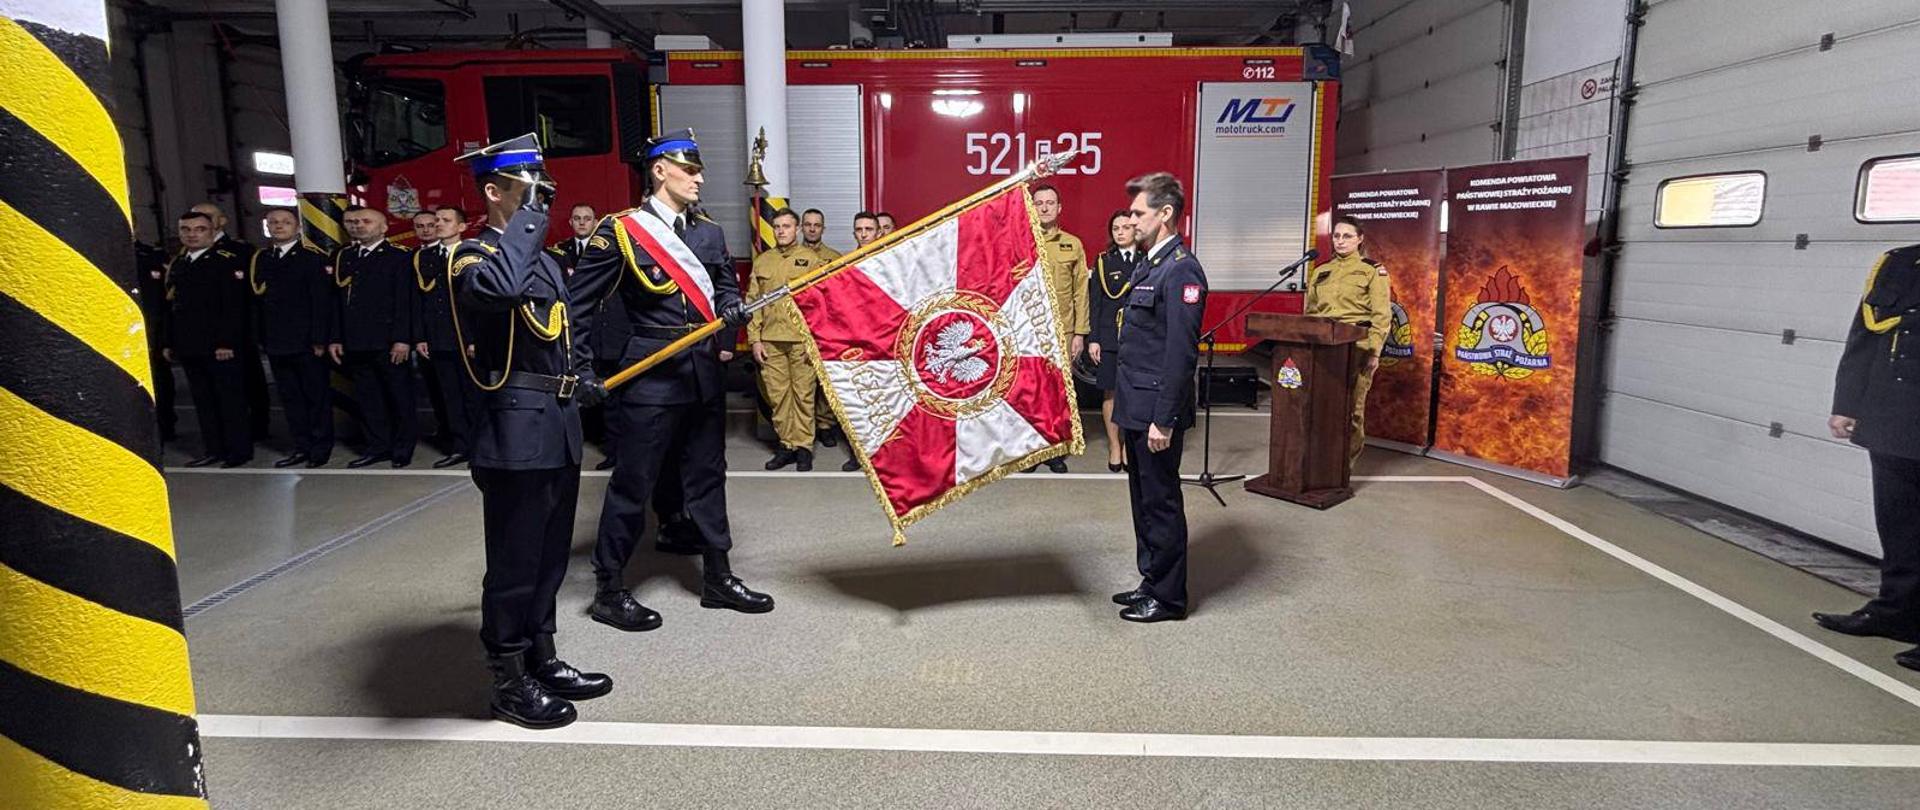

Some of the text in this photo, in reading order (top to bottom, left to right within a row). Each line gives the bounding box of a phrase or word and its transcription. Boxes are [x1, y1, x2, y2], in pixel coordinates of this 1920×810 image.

[1255, 67, 1275, 79] 112
[1216, 125, 1285, 134] mototruck.com
[1470, 173, 1557, 187] KOMENDA POWIATOWA
[1348, 188, 1419, 199] KOMENDA POWIATOWA
[1456, 184, 1572, 200] PAŃSTWOWEJ STRAŻY POŻARNEJ
[1467, 200, 1557, 212] W RAWIE MAZOWIECKIEJ
